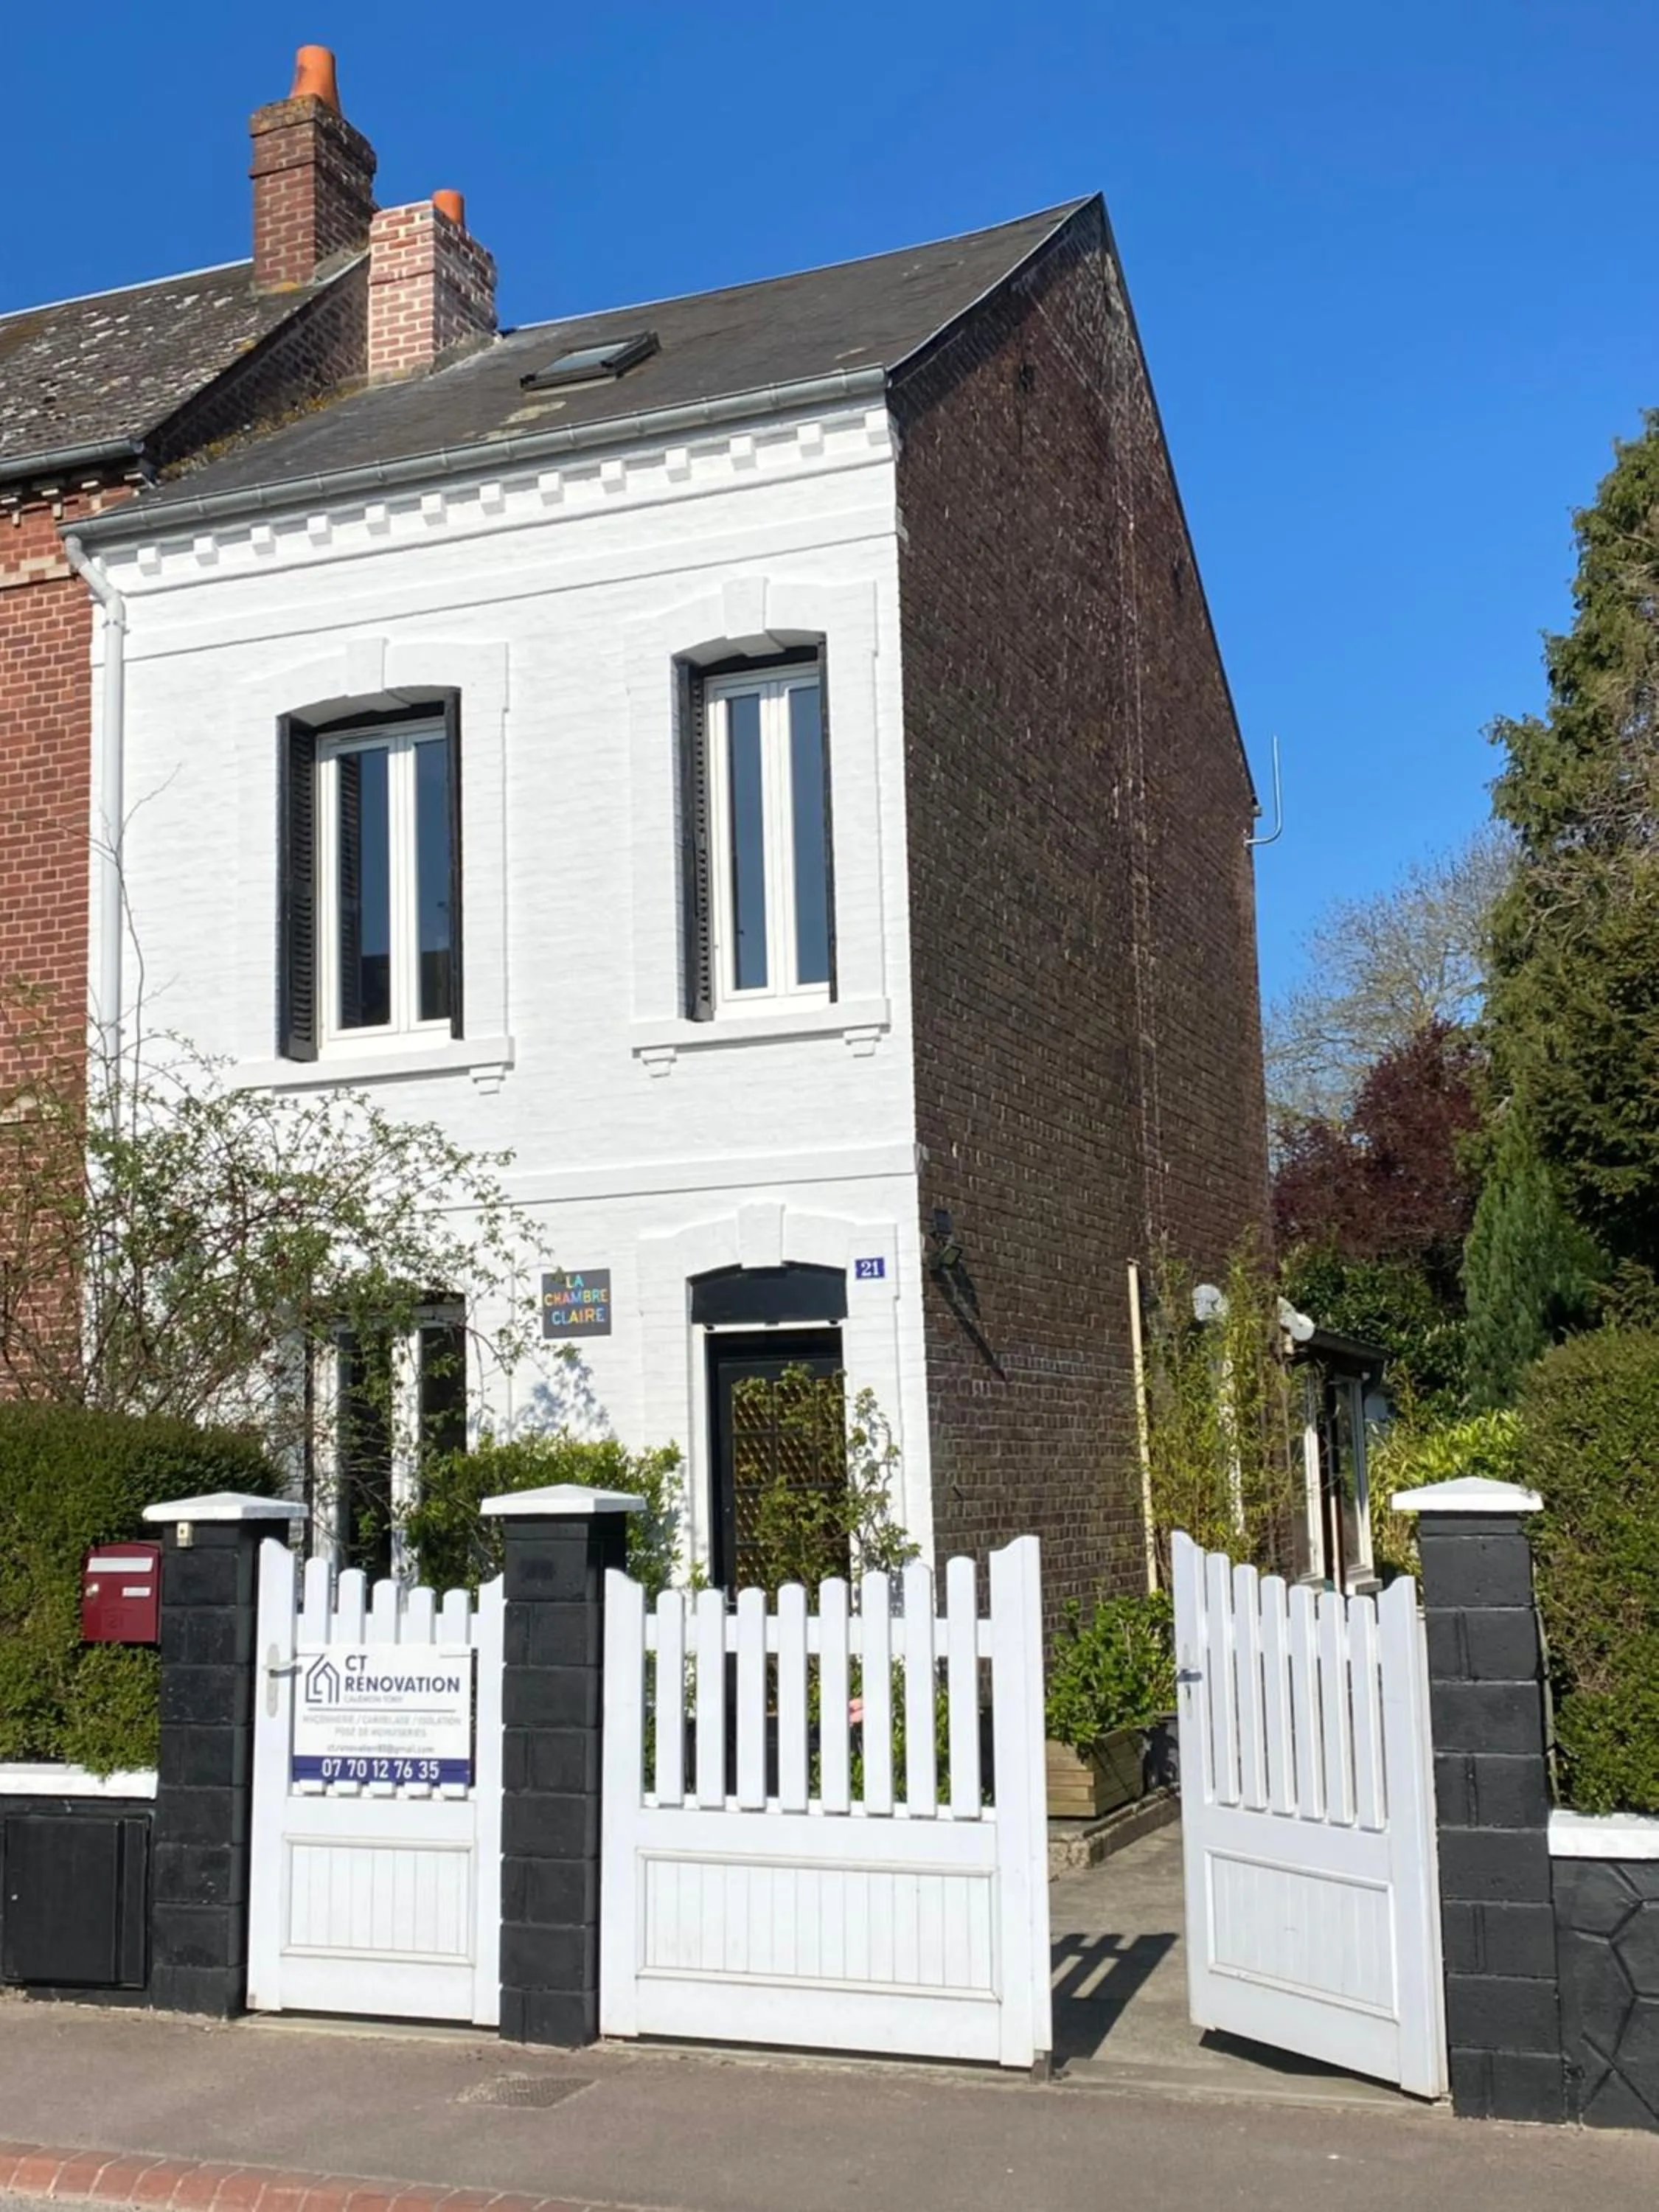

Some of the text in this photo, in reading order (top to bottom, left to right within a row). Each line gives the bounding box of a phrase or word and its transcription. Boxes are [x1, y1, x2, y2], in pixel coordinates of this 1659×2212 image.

[860, 1260, 878, 1276] 21
[566, 1274, 584, 1289] LA
[544, 1288, 608, 1307] CHAMBRE
[552, 1307, 605, 1325] CLAIRE
[345, 1655, 368, 1672] CT
[322, 1759, 440, 1780] 07 70 12 76 35
